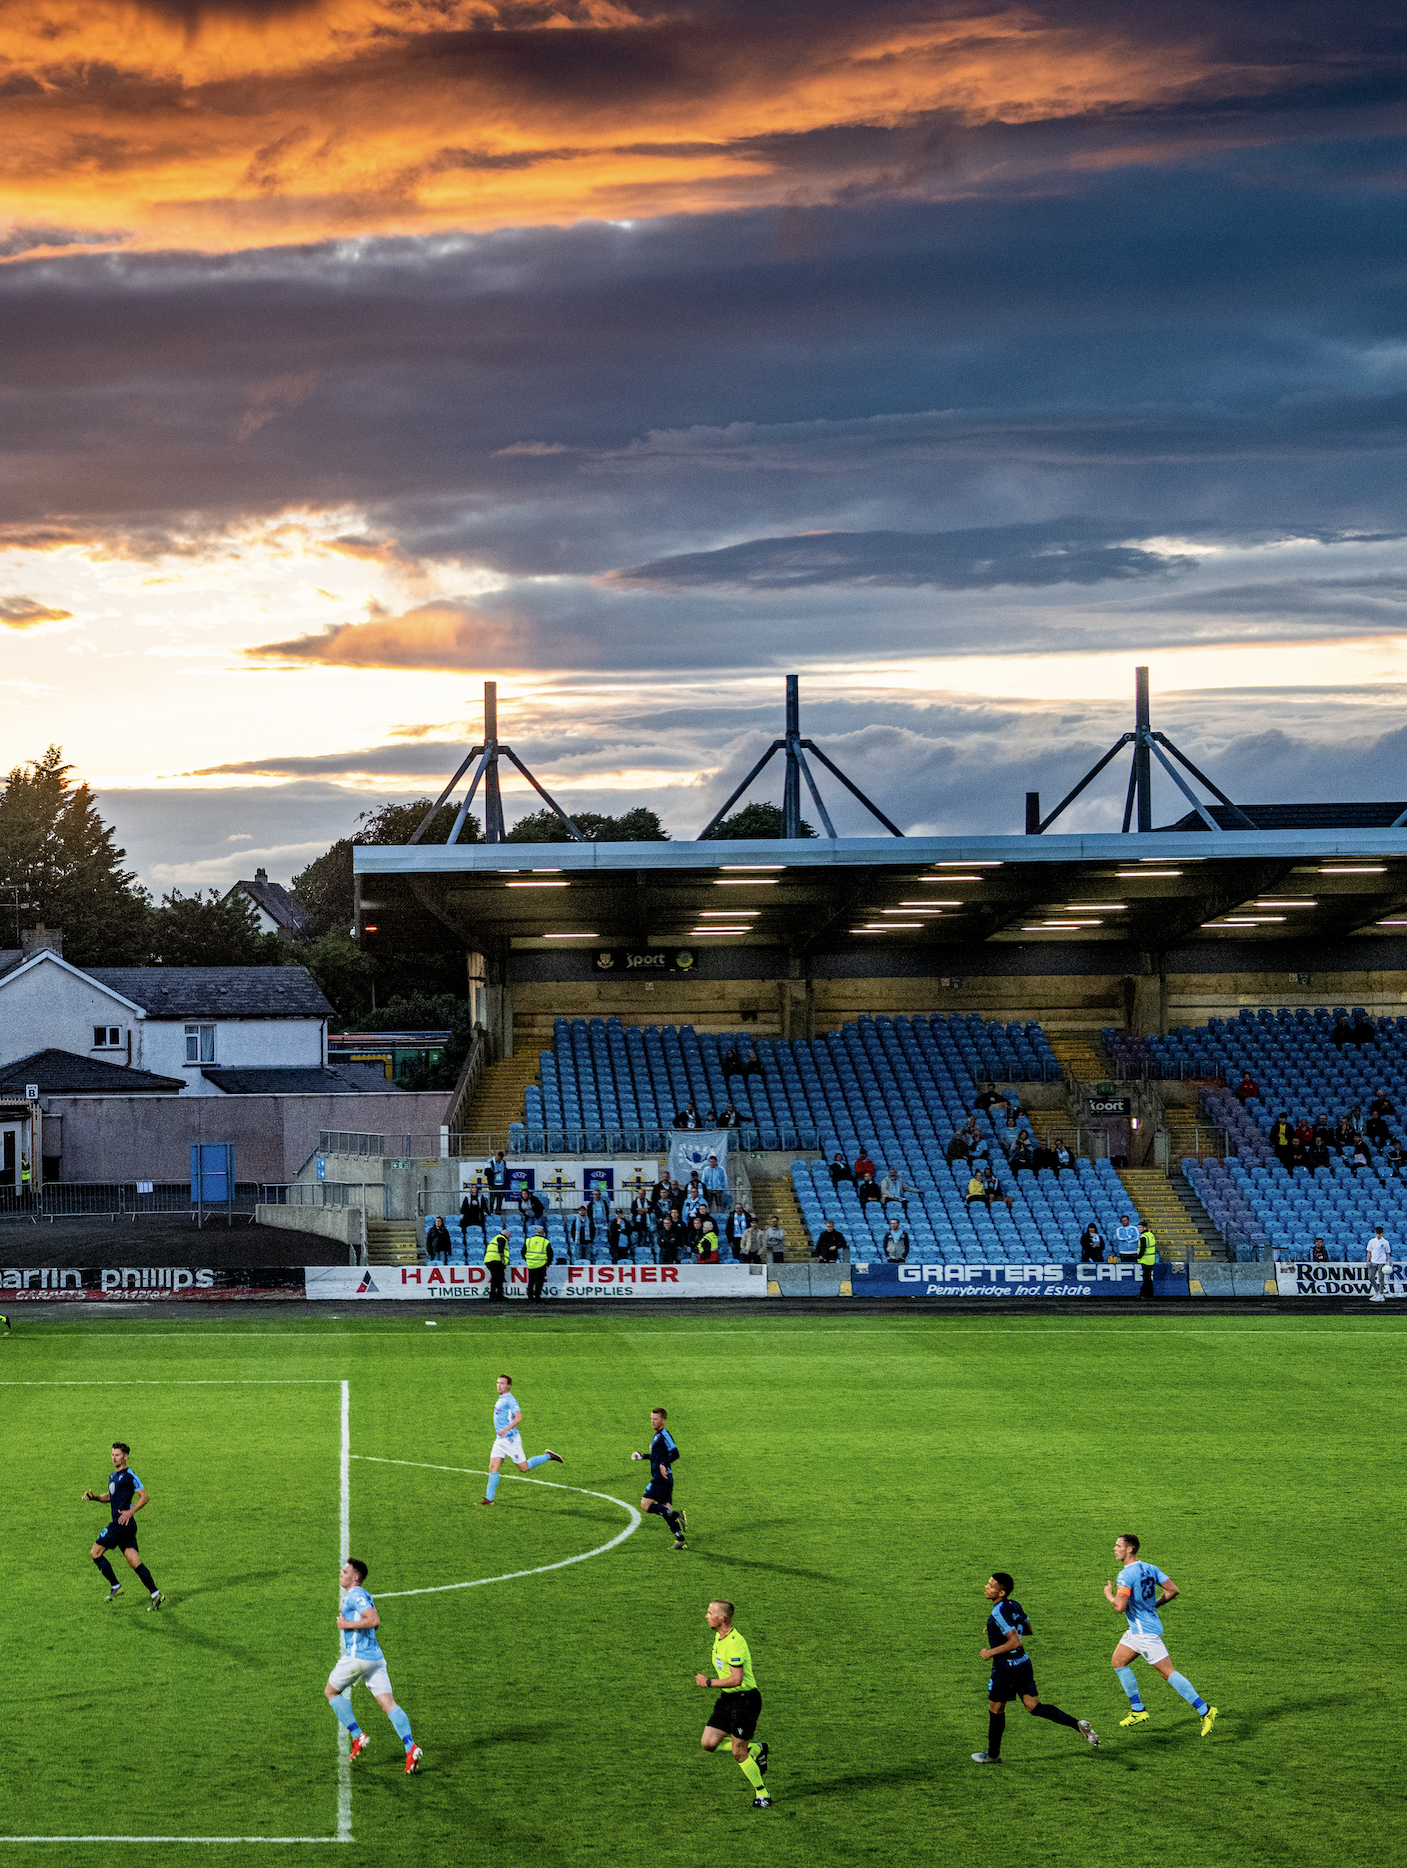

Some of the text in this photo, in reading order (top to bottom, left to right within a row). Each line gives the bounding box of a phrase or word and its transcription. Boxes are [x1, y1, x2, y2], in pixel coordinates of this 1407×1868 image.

[568, 1266, 680, 1284] FISHER
[898, 1264, 1064, 1282] GRAFTERS
[428, 1286, 480, 1298] TIMBER
[566, 1286, 634, 1297] SUPPLIES
[926, 1284, 1092, 1297] Pennybridge Ind. Estate
[1141, 1577, 1155, 1600] 23
